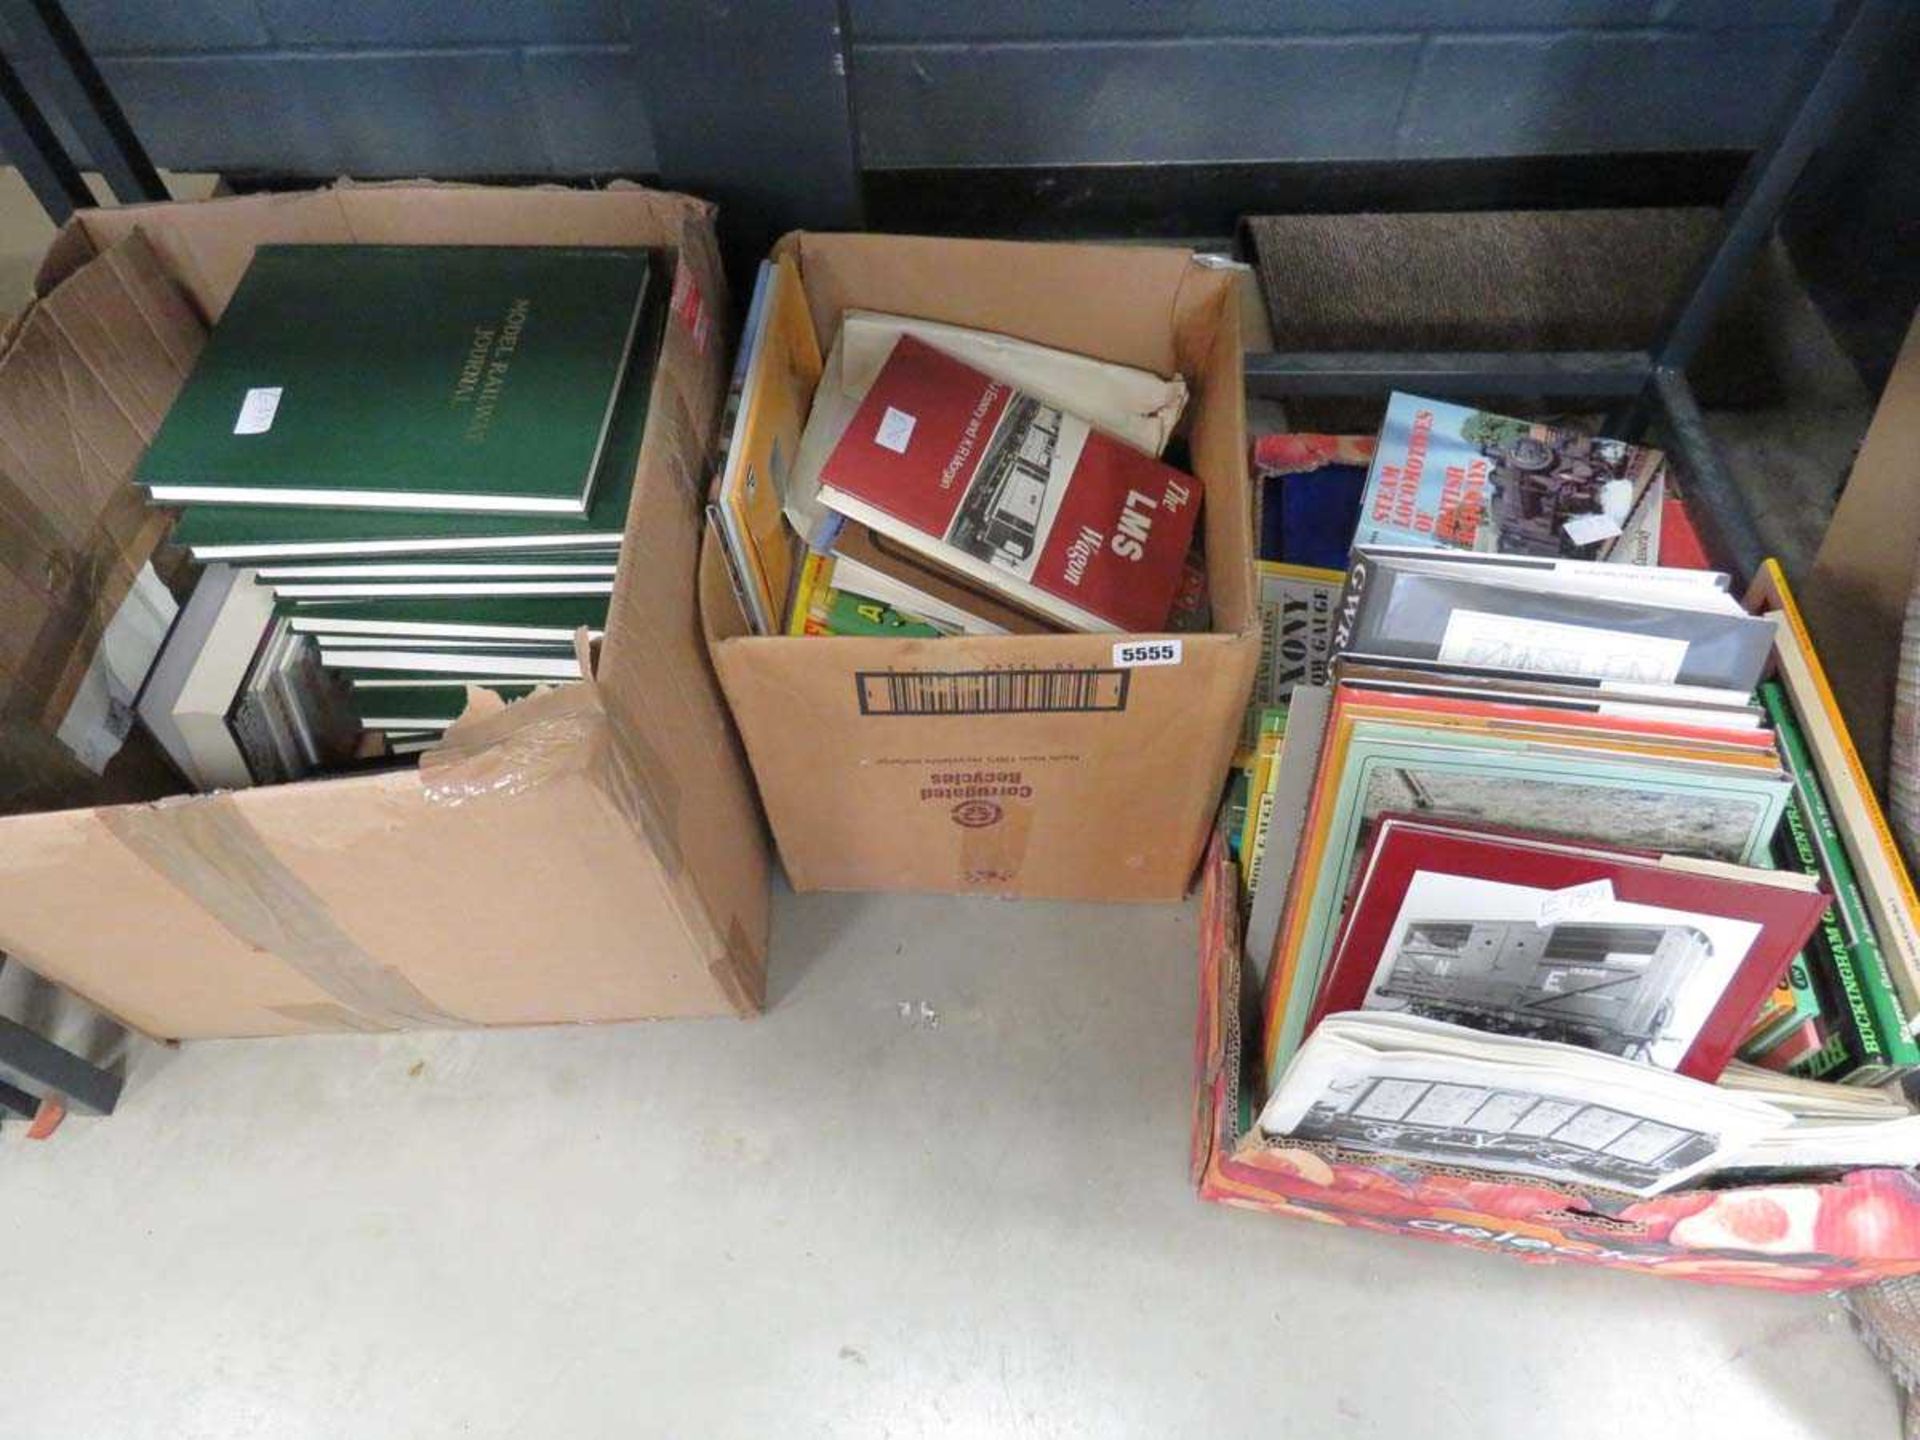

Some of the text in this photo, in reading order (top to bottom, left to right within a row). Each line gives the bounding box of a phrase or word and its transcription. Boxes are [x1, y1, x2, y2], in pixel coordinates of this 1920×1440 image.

[450, 327, 493, 408] JOURNAL
[464, 298, 530, 444] MODEL RAILWAY
[1164, 480, 1190, 513] The
[1373, 465, 1399, 523] STEAM
[1393, 410, 1433, 528] LOCOMOTIVES
[1112, 489, 1157, 562] LMS
[1415, 513, 1433, 533] OF
[1064, 526, 1104, 586] Wagon
[1334, 564, 1366, 648] GWR
[1122, 646, 1174, 661] 5555
[920, 785, 1033, 801] Corrugated
[930, 771, 1022, 787] Recycles
[1825, 924, 1882, 1055] BUCKINGHAM
